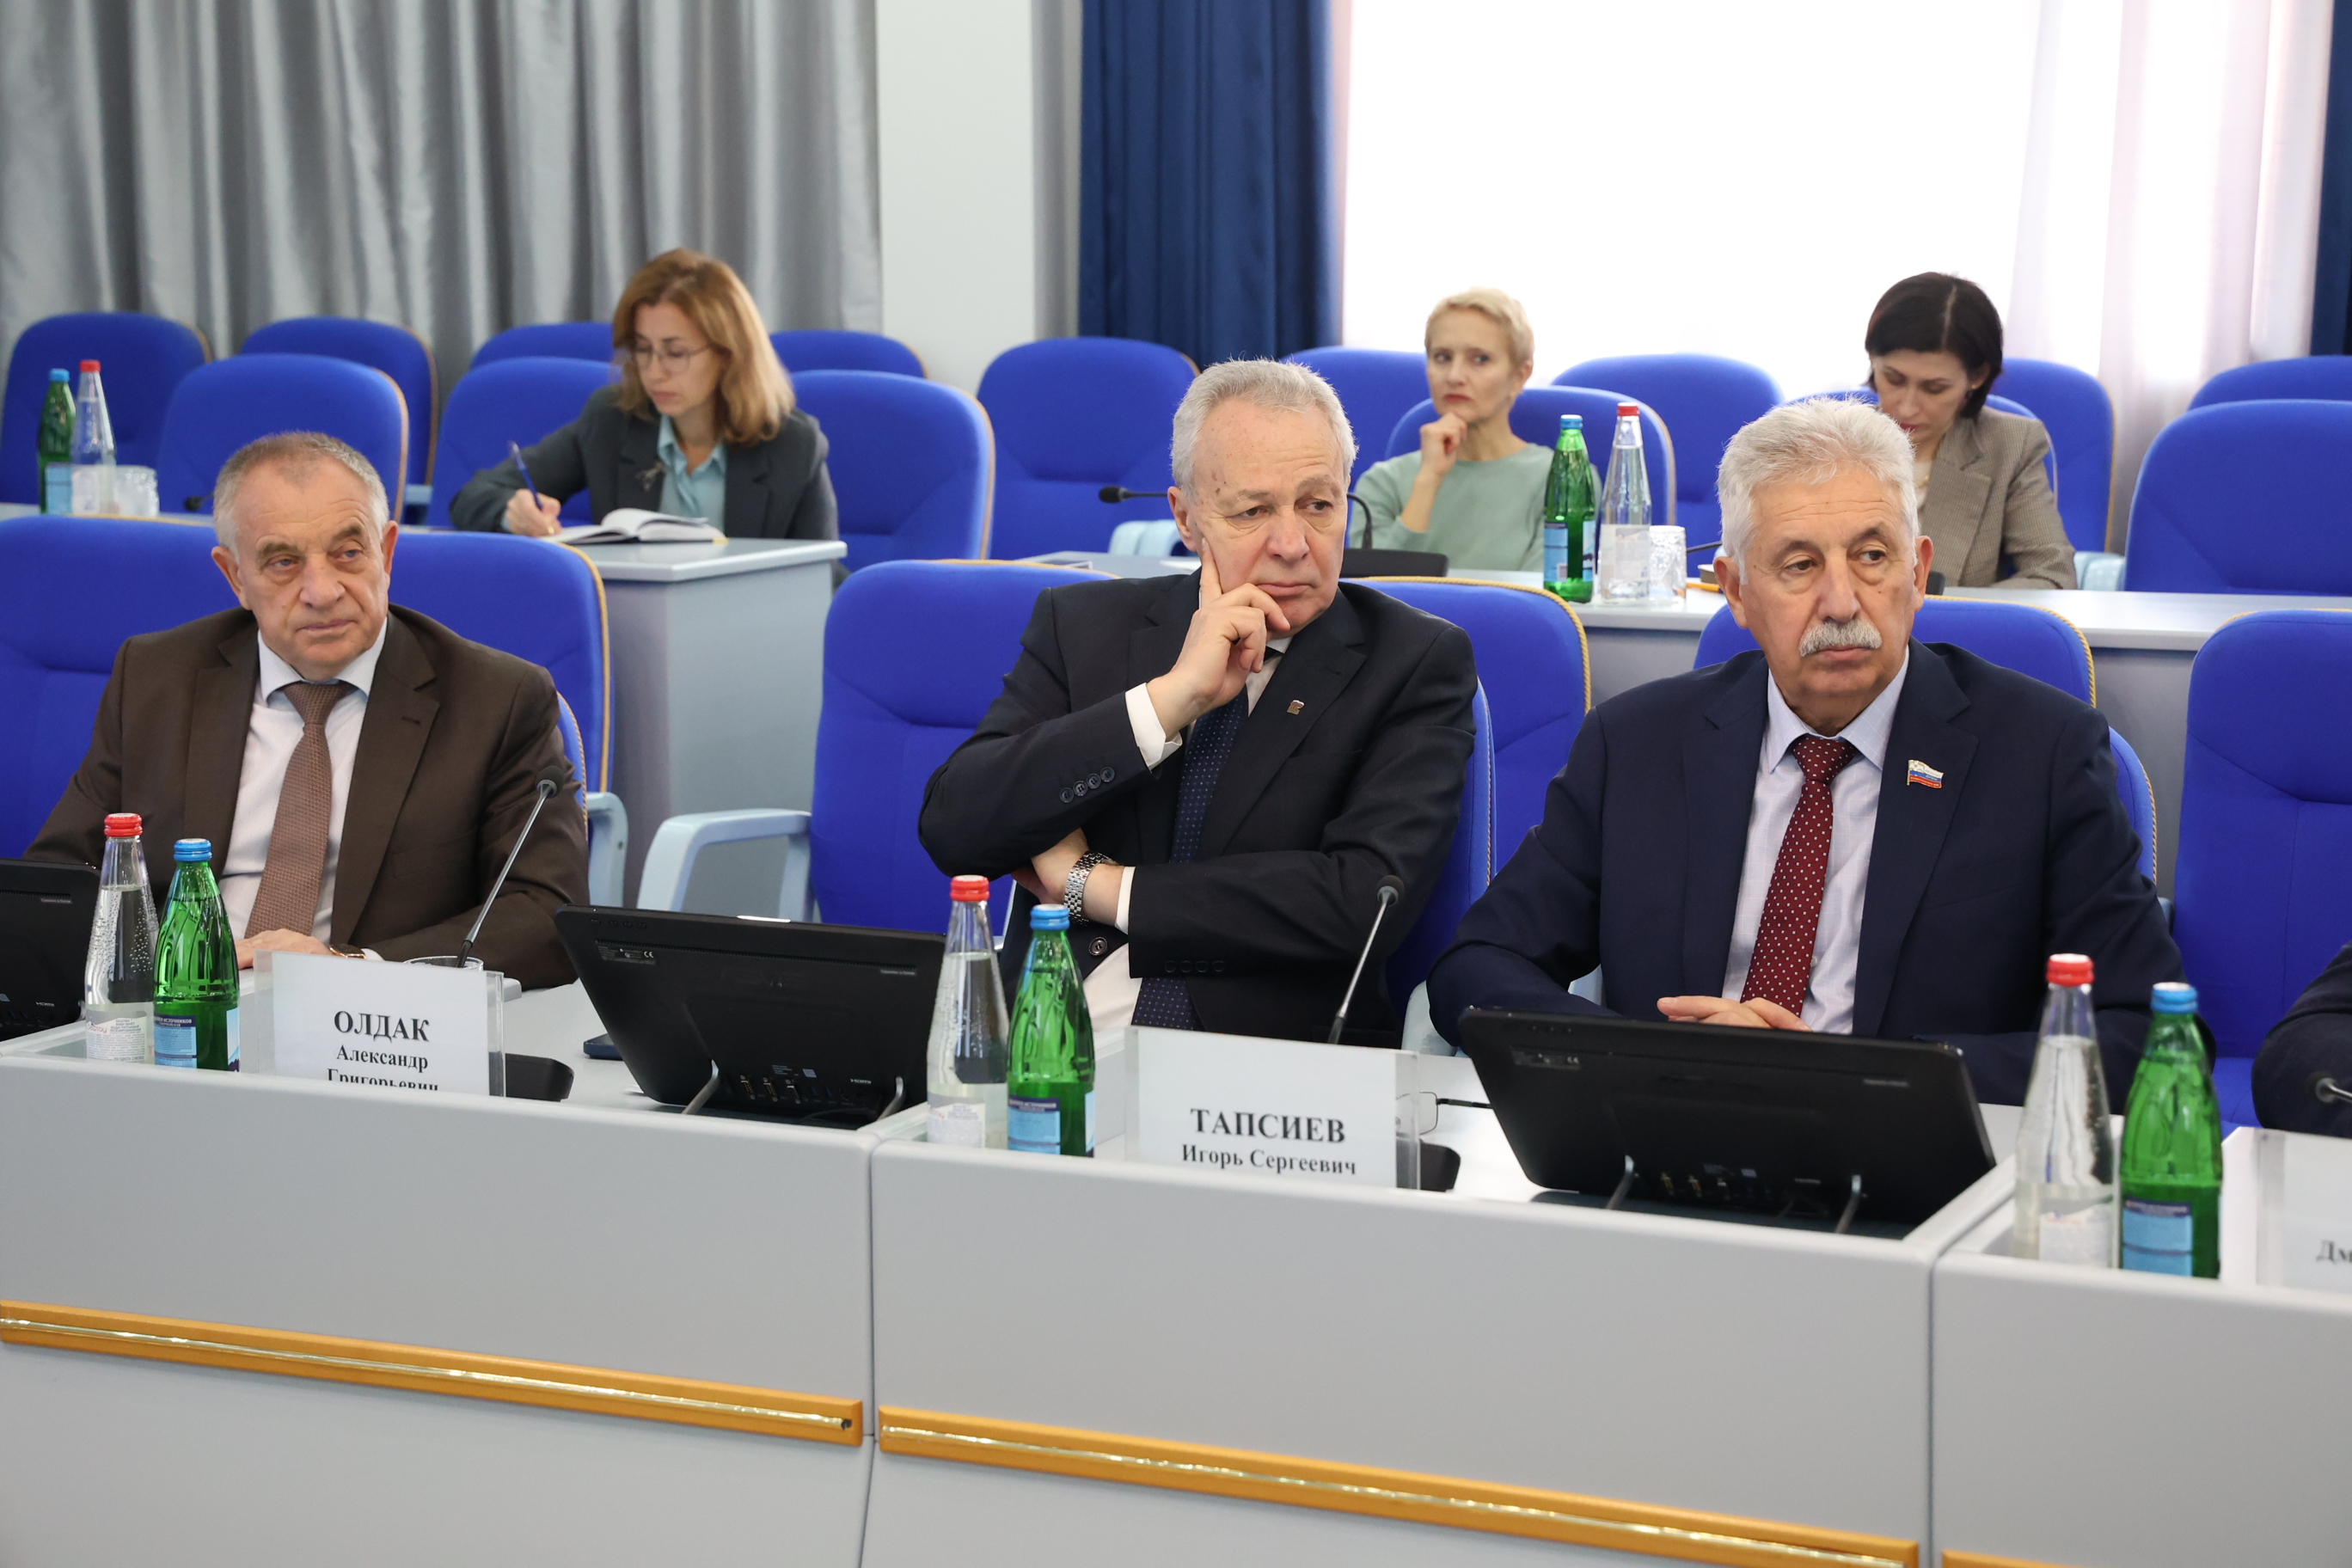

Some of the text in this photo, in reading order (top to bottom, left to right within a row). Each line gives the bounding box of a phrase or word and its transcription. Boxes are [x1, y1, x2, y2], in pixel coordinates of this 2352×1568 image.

[334, 1010, 430, 1043] ОЛДАК
[336, 1044, 428, 1074] Александр
[1190, 1108, 1345, 1143] ТАПСИЕВ
[1182, 1144, 1357, 1175] Игорь Сергеевич
